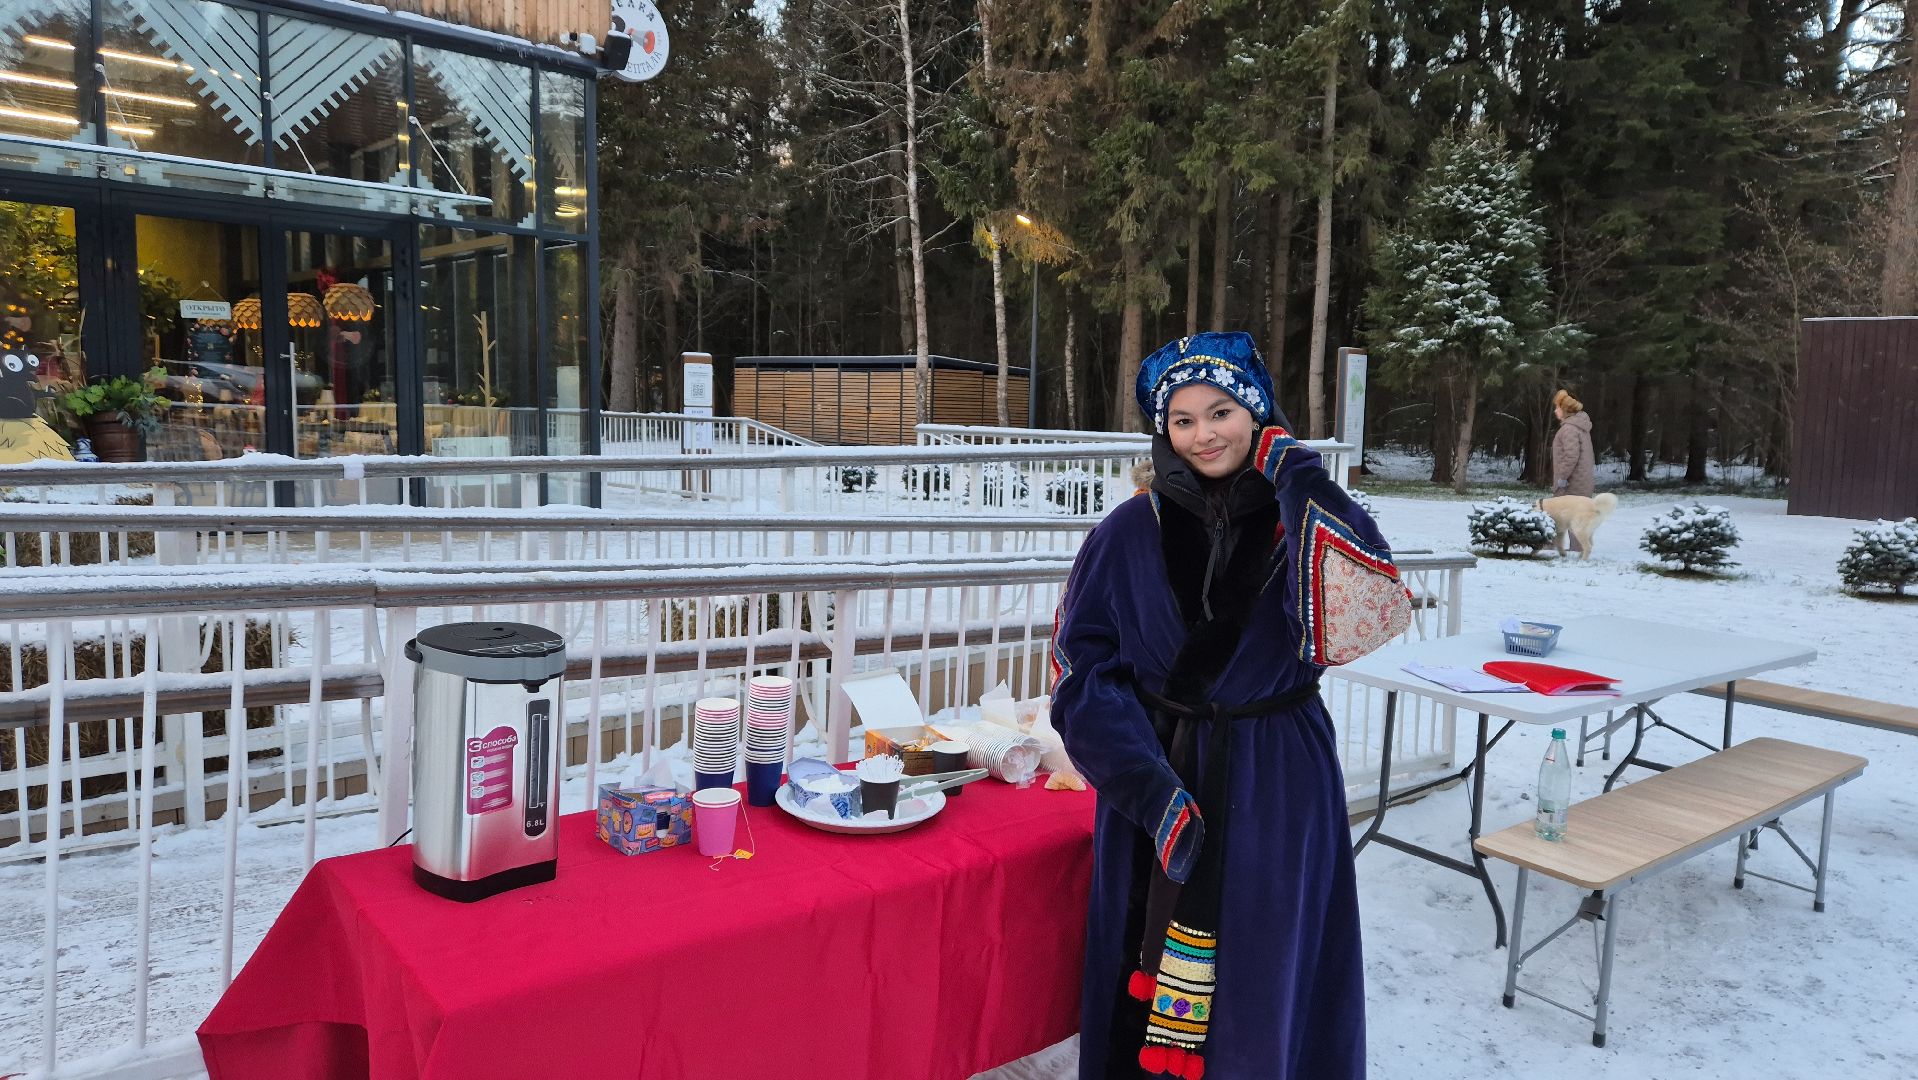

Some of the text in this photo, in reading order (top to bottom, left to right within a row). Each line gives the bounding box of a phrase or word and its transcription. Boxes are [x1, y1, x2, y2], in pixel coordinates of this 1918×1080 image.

[627, 52, 662, 74] ЕПТАЛА
[185, 304, 226, 312] ОТКРЫТО
[468, 740, 483, 752] 3
[482, 735, 517, 749] способа
[526, 819, 545, 828] 6.8L
